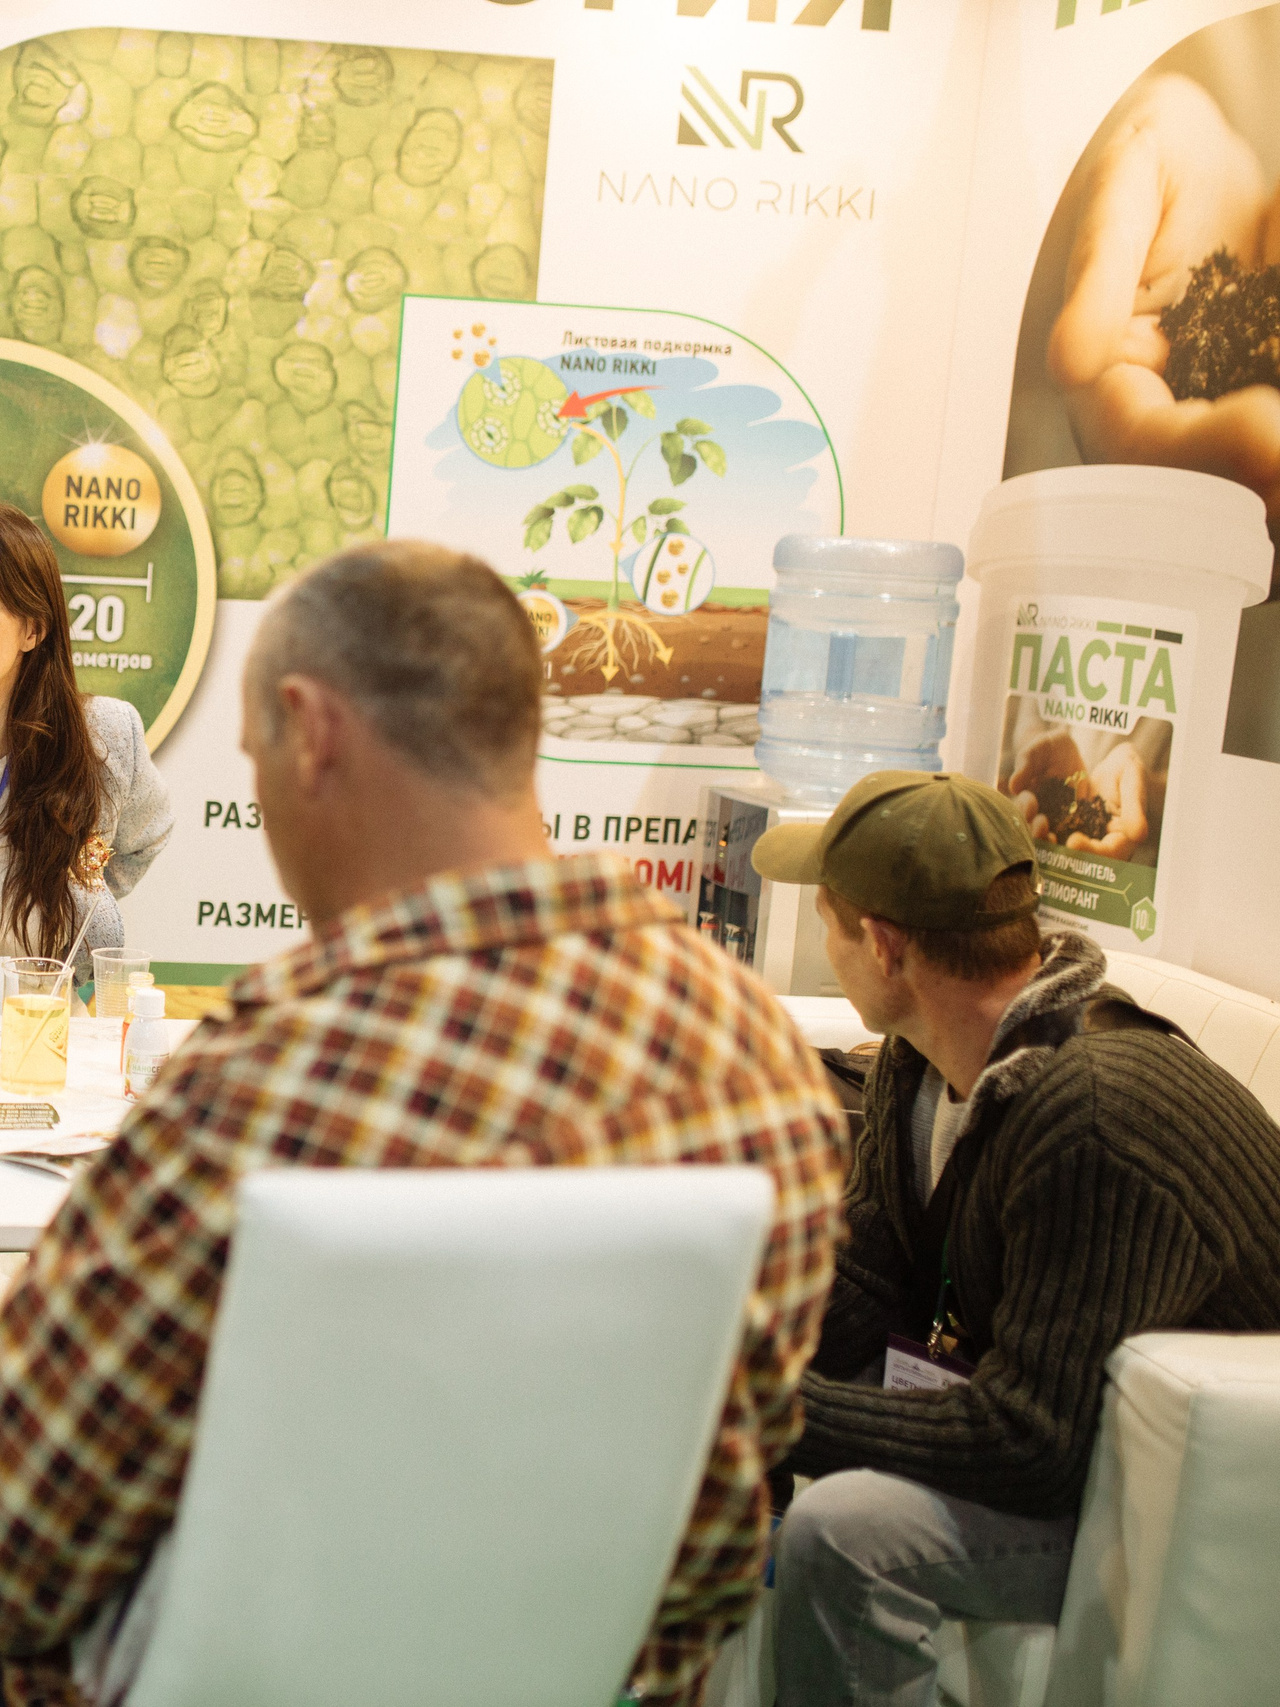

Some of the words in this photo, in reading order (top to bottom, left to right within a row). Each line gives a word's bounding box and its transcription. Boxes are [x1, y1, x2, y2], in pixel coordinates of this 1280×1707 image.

[597, 170, 738, 212] NANO
[756, 179, 876, 221] RIKKI
[561, 330, 637, 349] Листовая
[643, 339, 733, 359] подкормка
[559, 355, 607, 373] NANO
[612, 358, 657, 377] RIKKI
[65, 474, 142, 501] NANO
[63, 504, 136, 530] RIKKI
[67, 593, 126, 643] 20
[1009, 633, 1178, 714] ПАСТА
[1044, 698, 1086, 721] NANO
[1089, 706, 1129, 729] RIKKI
[204, 801, 262, 829] РАЗ
[573, 814, 591, 841] В
